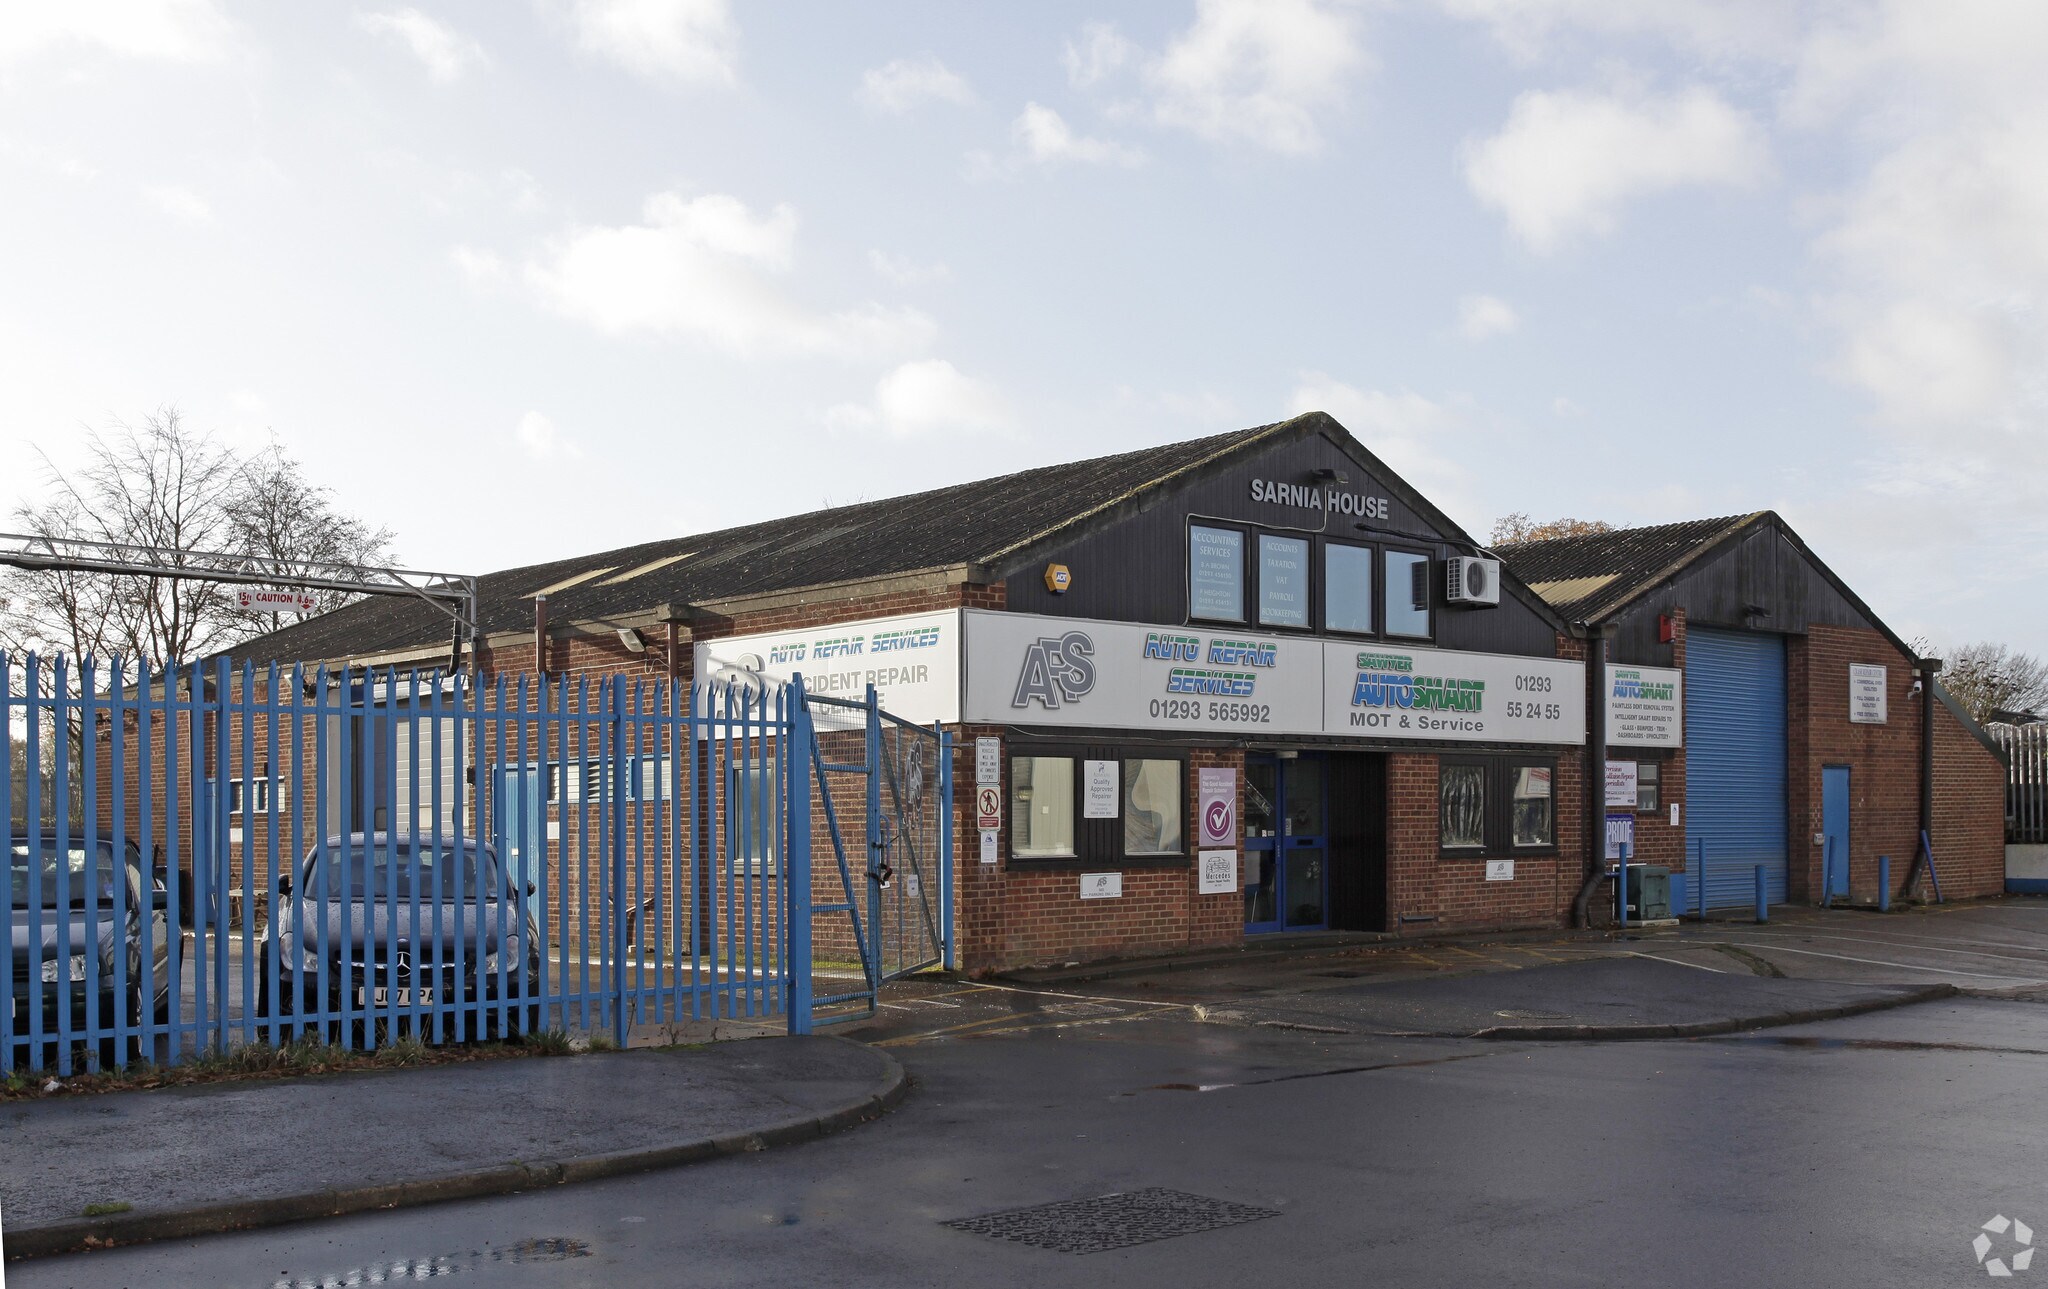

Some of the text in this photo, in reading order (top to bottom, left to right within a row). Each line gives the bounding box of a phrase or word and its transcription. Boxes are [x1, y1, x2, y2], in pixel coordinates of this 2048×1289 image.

[1251, 479, 1389, 520] SARNIA HOUSE
[1191, 532, 1239, 547] ACCOUNTING
[1266, 542, 1298, 553] ACCOUNTS
[1200, 545, 1231, 558] SERVICES
[1267, 558, 1297, 569] TAXATION
[1275, 576, 1288, 585] VAT
[238, 592, 315, 604] 15ft CAUTION 4.6m
[1269, 591, 1294, 602] PAYROLL
[1261, 607, 1302, 619] BOOKKEEPING
[769, 625, 942, 665] AUTO REPAIR SERVICES
[1144, 632, 1277, 668] AUTO REPAIR
[1357, 652, 1413, 672] SAWYER
[782, 664, 928, 697] CIDENT REPAIR
[1166, 667, 1257, 697] SERVICES
[1515, 674, 1552, 693] 01293
[1614, 670, 1641, 680] SAWYER
[1352, 672, 1486, 713] AUTOSMART
[1612, 680, 1674, 701] AUTOSMART
[1149, 698, 1271, 723] 01293 565992
[1506, 701, 1560, 720] 55 24 55
[1612, 702, 1632, 710] PAINTLESS
[1349, 712, 1485, 732] MOT & Service
